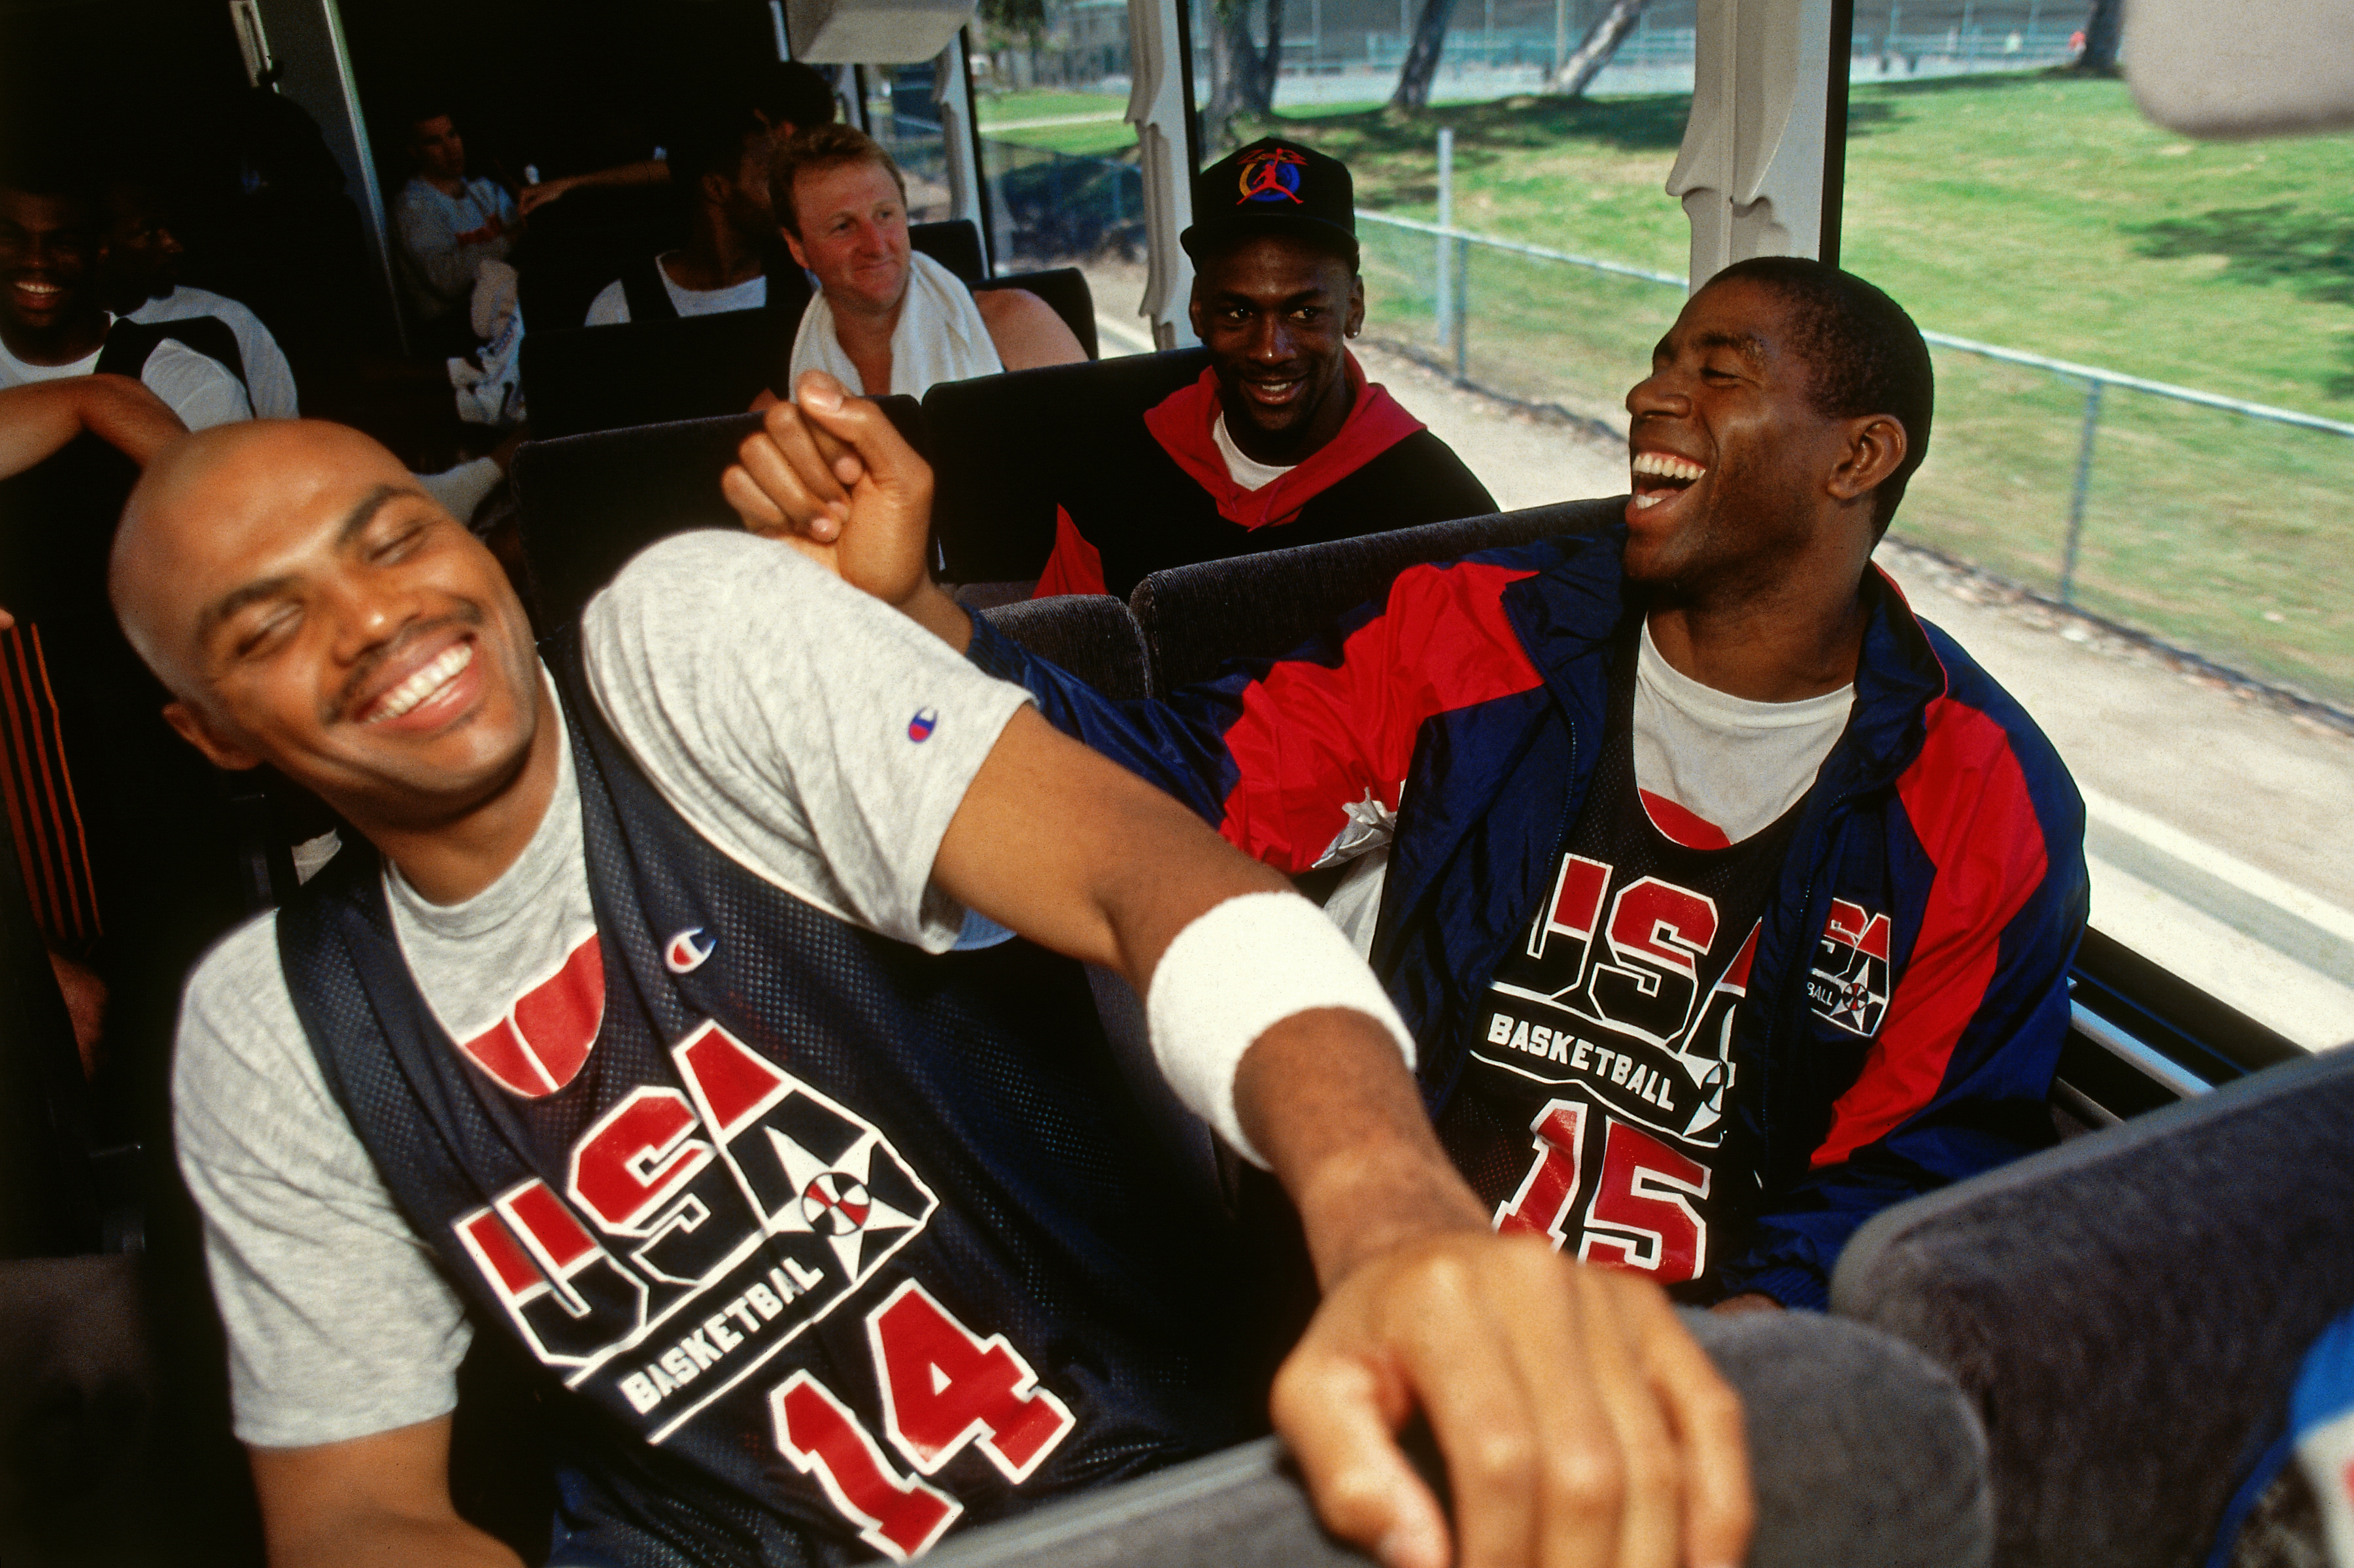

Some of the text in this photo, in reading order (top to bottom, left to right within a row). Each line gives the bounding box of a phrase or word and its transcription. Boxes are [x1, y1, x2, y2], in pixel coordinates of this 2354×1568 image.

[1811, 897, 1892, 1010] SA
[1486, 1012, 1676, 1112] BASKETBALL
[452, 1017, 941, 1370] USA
[1492, 1098, 1712, 1286] 15
[768, 1276, 1078, 1565] 14
